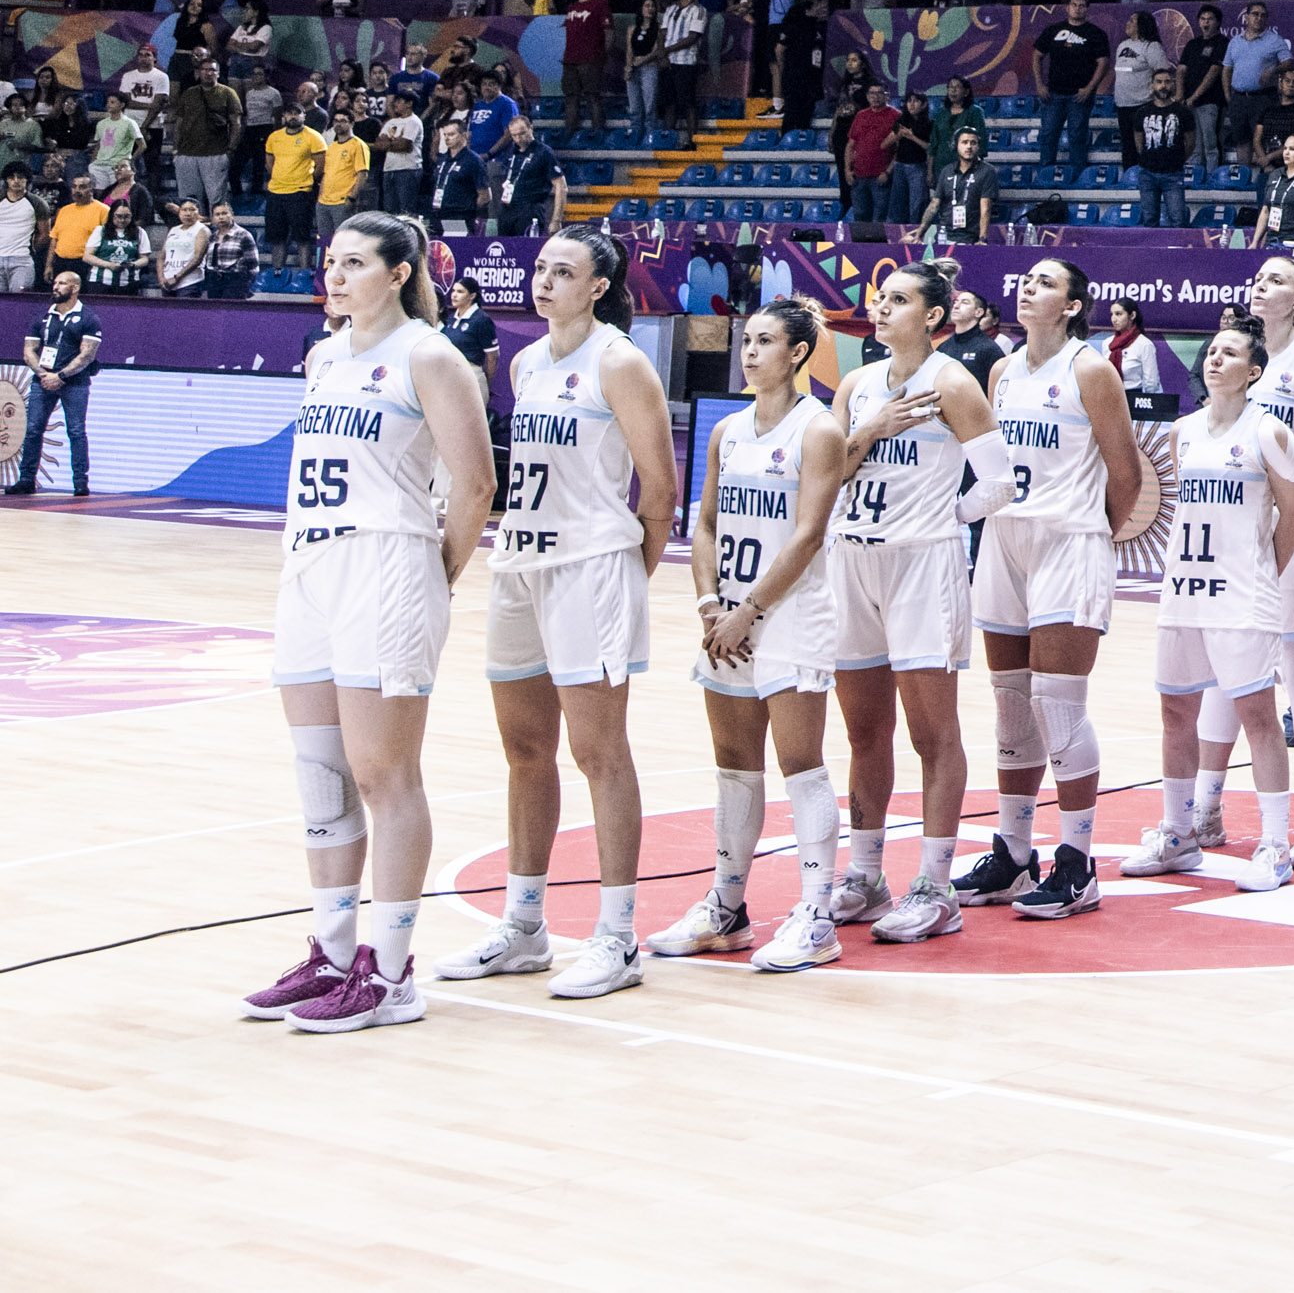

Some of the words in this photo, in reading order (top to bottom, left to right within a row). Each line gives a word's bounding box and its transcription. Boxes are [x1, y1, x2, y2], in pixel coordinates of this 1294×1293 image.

[472, 109, 492, 120] TEC
[474, 257, 516, 267] WOMEN'S
[497, 290, 524, 304] 2023
[1088, 273, 1173, 303] omen's
[1178, 278, 1251, 304] Ameri
[510, 413, 578, 447] GENTINA
[999, 420, 1059, 449] GENTINA
[298, 458, 349, 508] 55
[509, 462, 549, 511] 27
[1178, 479, 1243, 505] RGENTINA
[717, 486, 788, 520] GENTINA
[847, 479, 887, 524] 14
[503, 529, 559, 554] YPF
[1179, 523, 1215, 563] 11
[720, 534, 763, 583] 20
[1171, 577, 1227, 597] YPF
